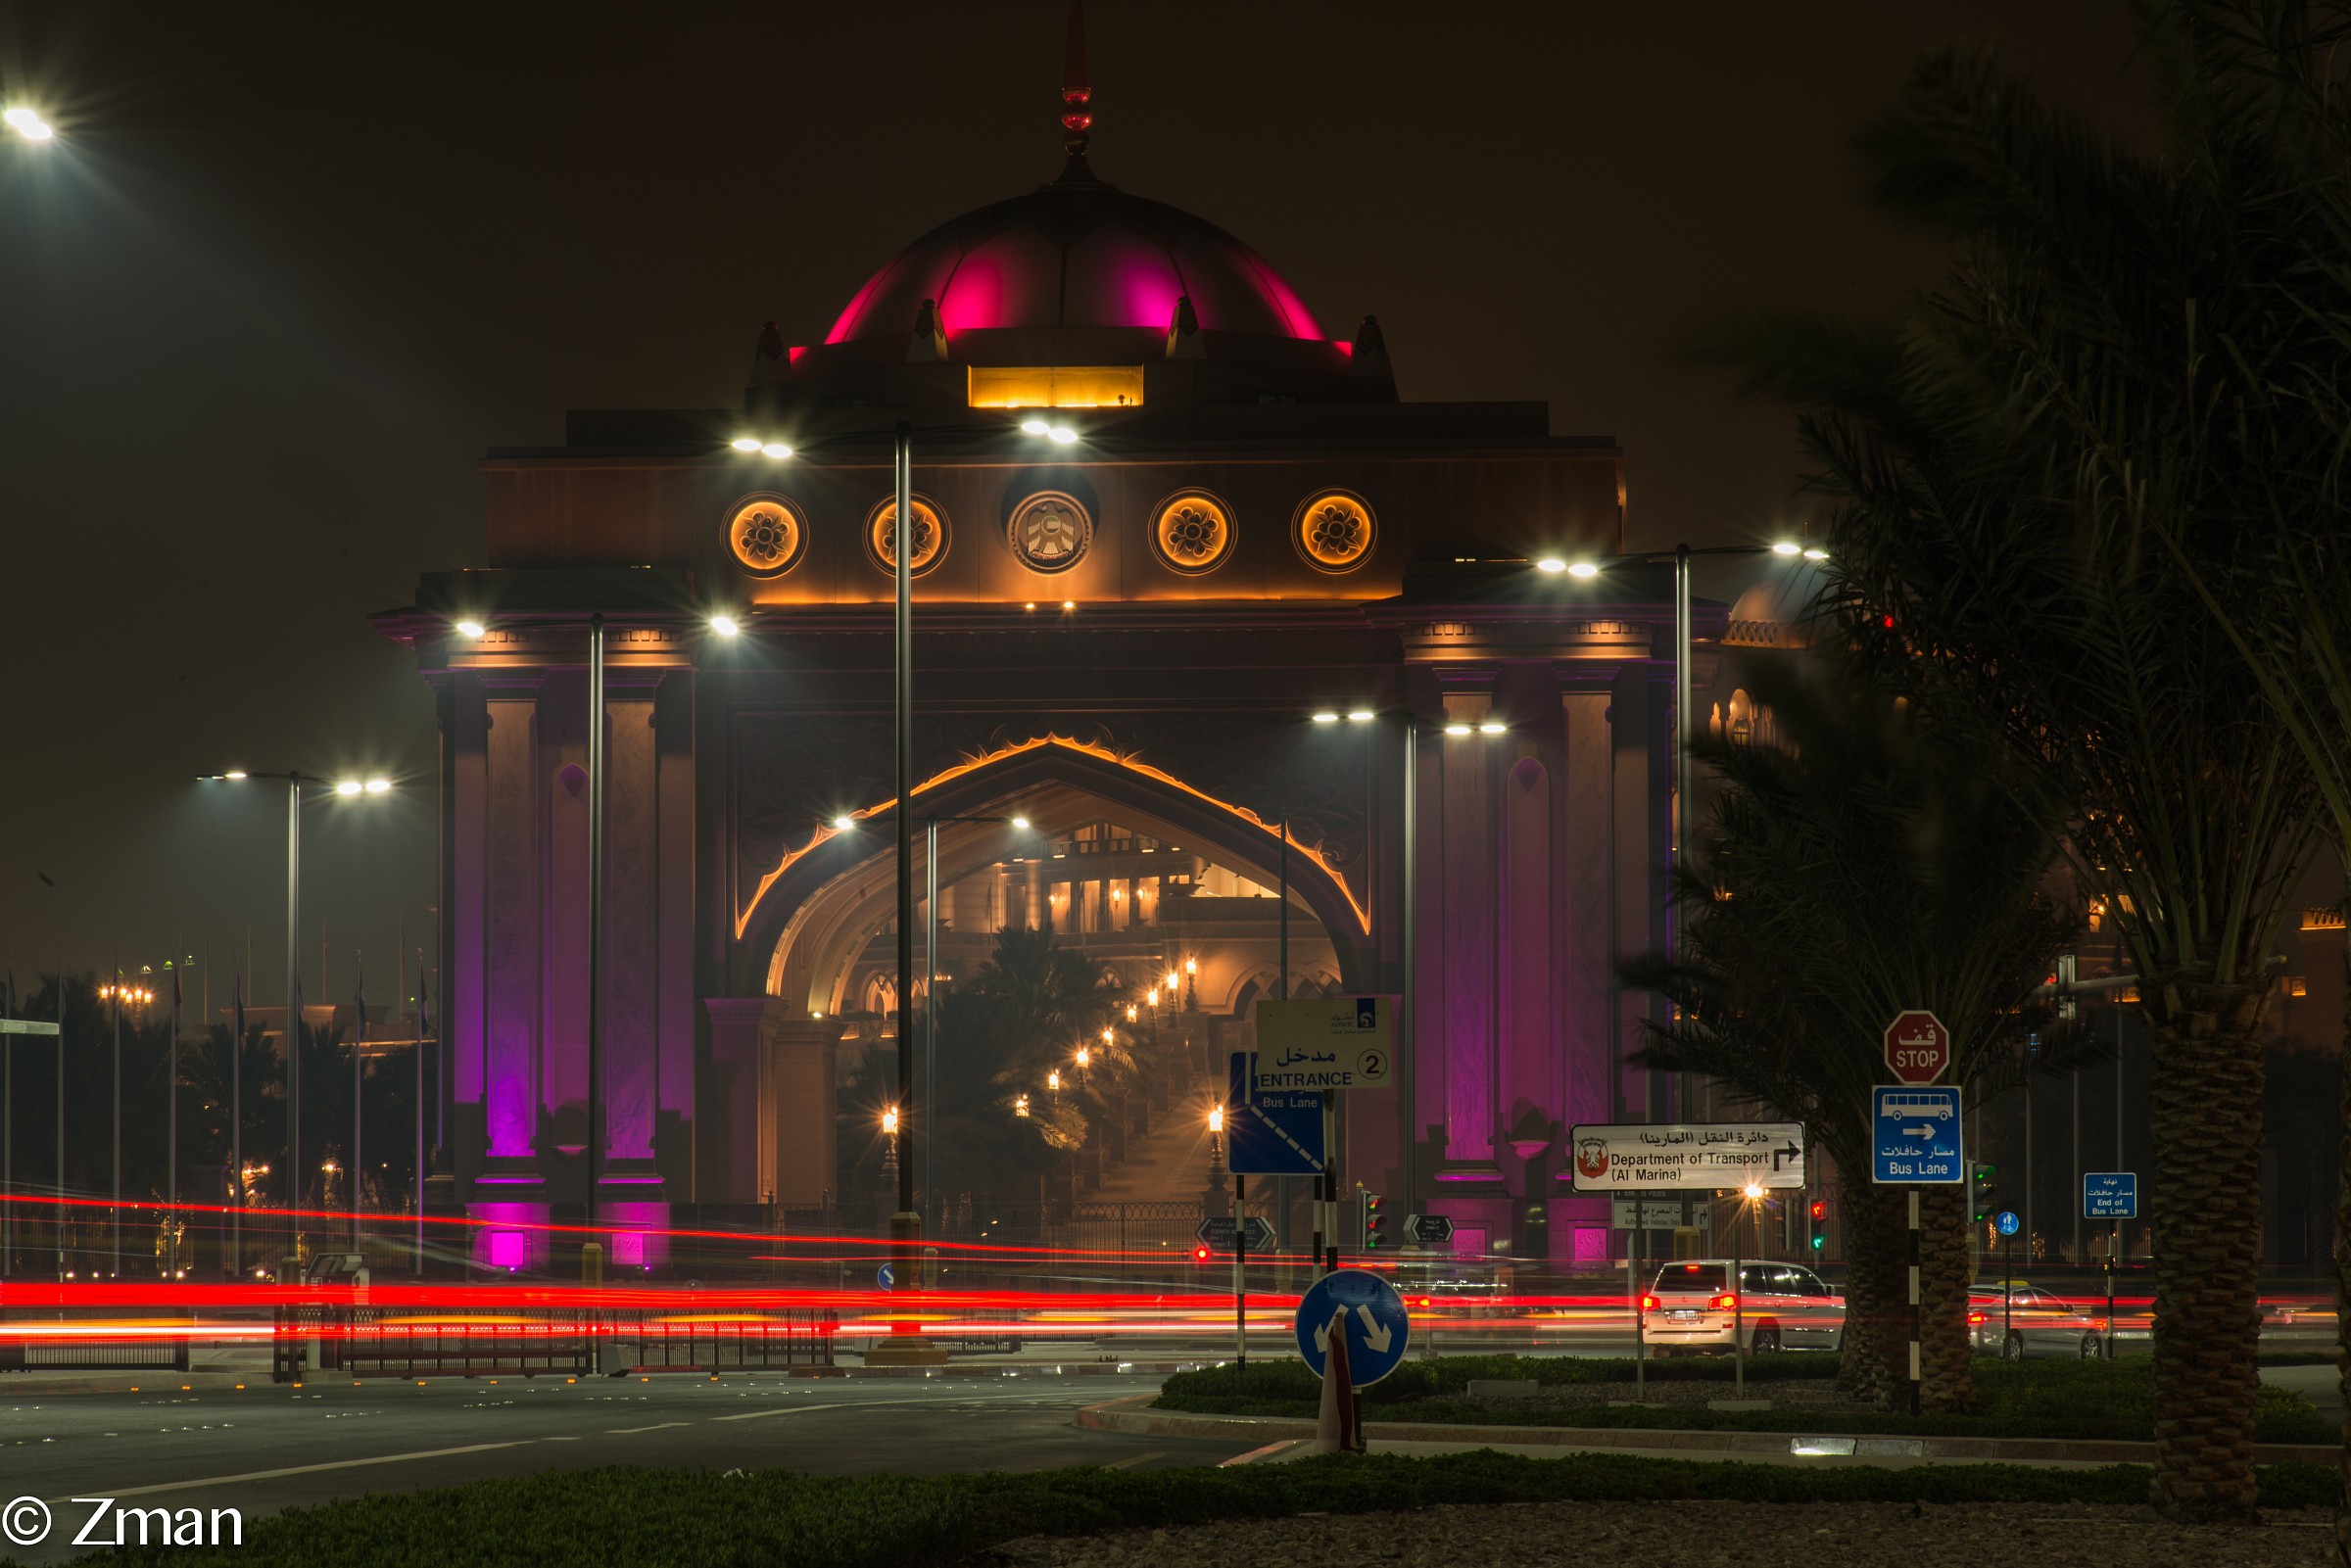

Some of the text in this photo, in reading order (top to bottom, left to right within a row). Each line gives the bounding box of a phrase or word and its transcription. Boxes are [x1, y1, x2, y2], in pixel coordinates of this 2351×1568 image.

[1898, 1024, 1937, 1046] قف
[1276, 1047, 1336, 1067] مدخل
[1366, 1055, 1379, 1074] 2
[1896, 1050, 1939, 1068] STOP
[1261, 1072, 1353, 1087] ENTRANCE
[1263, 1097, 1318, 1108] Bus Lane
[1640, 1131, 1768, 1147] دائرة النقل (المارينا)
[1611, 1152, 1768, 1166] Department of Transport
[1882, 1145, 1954, 1159] مسار حافلات
[1611, 1167, 1682, 1182] (Al Marina)
[1890, 1162, 1948, 1174] Bus Lane
